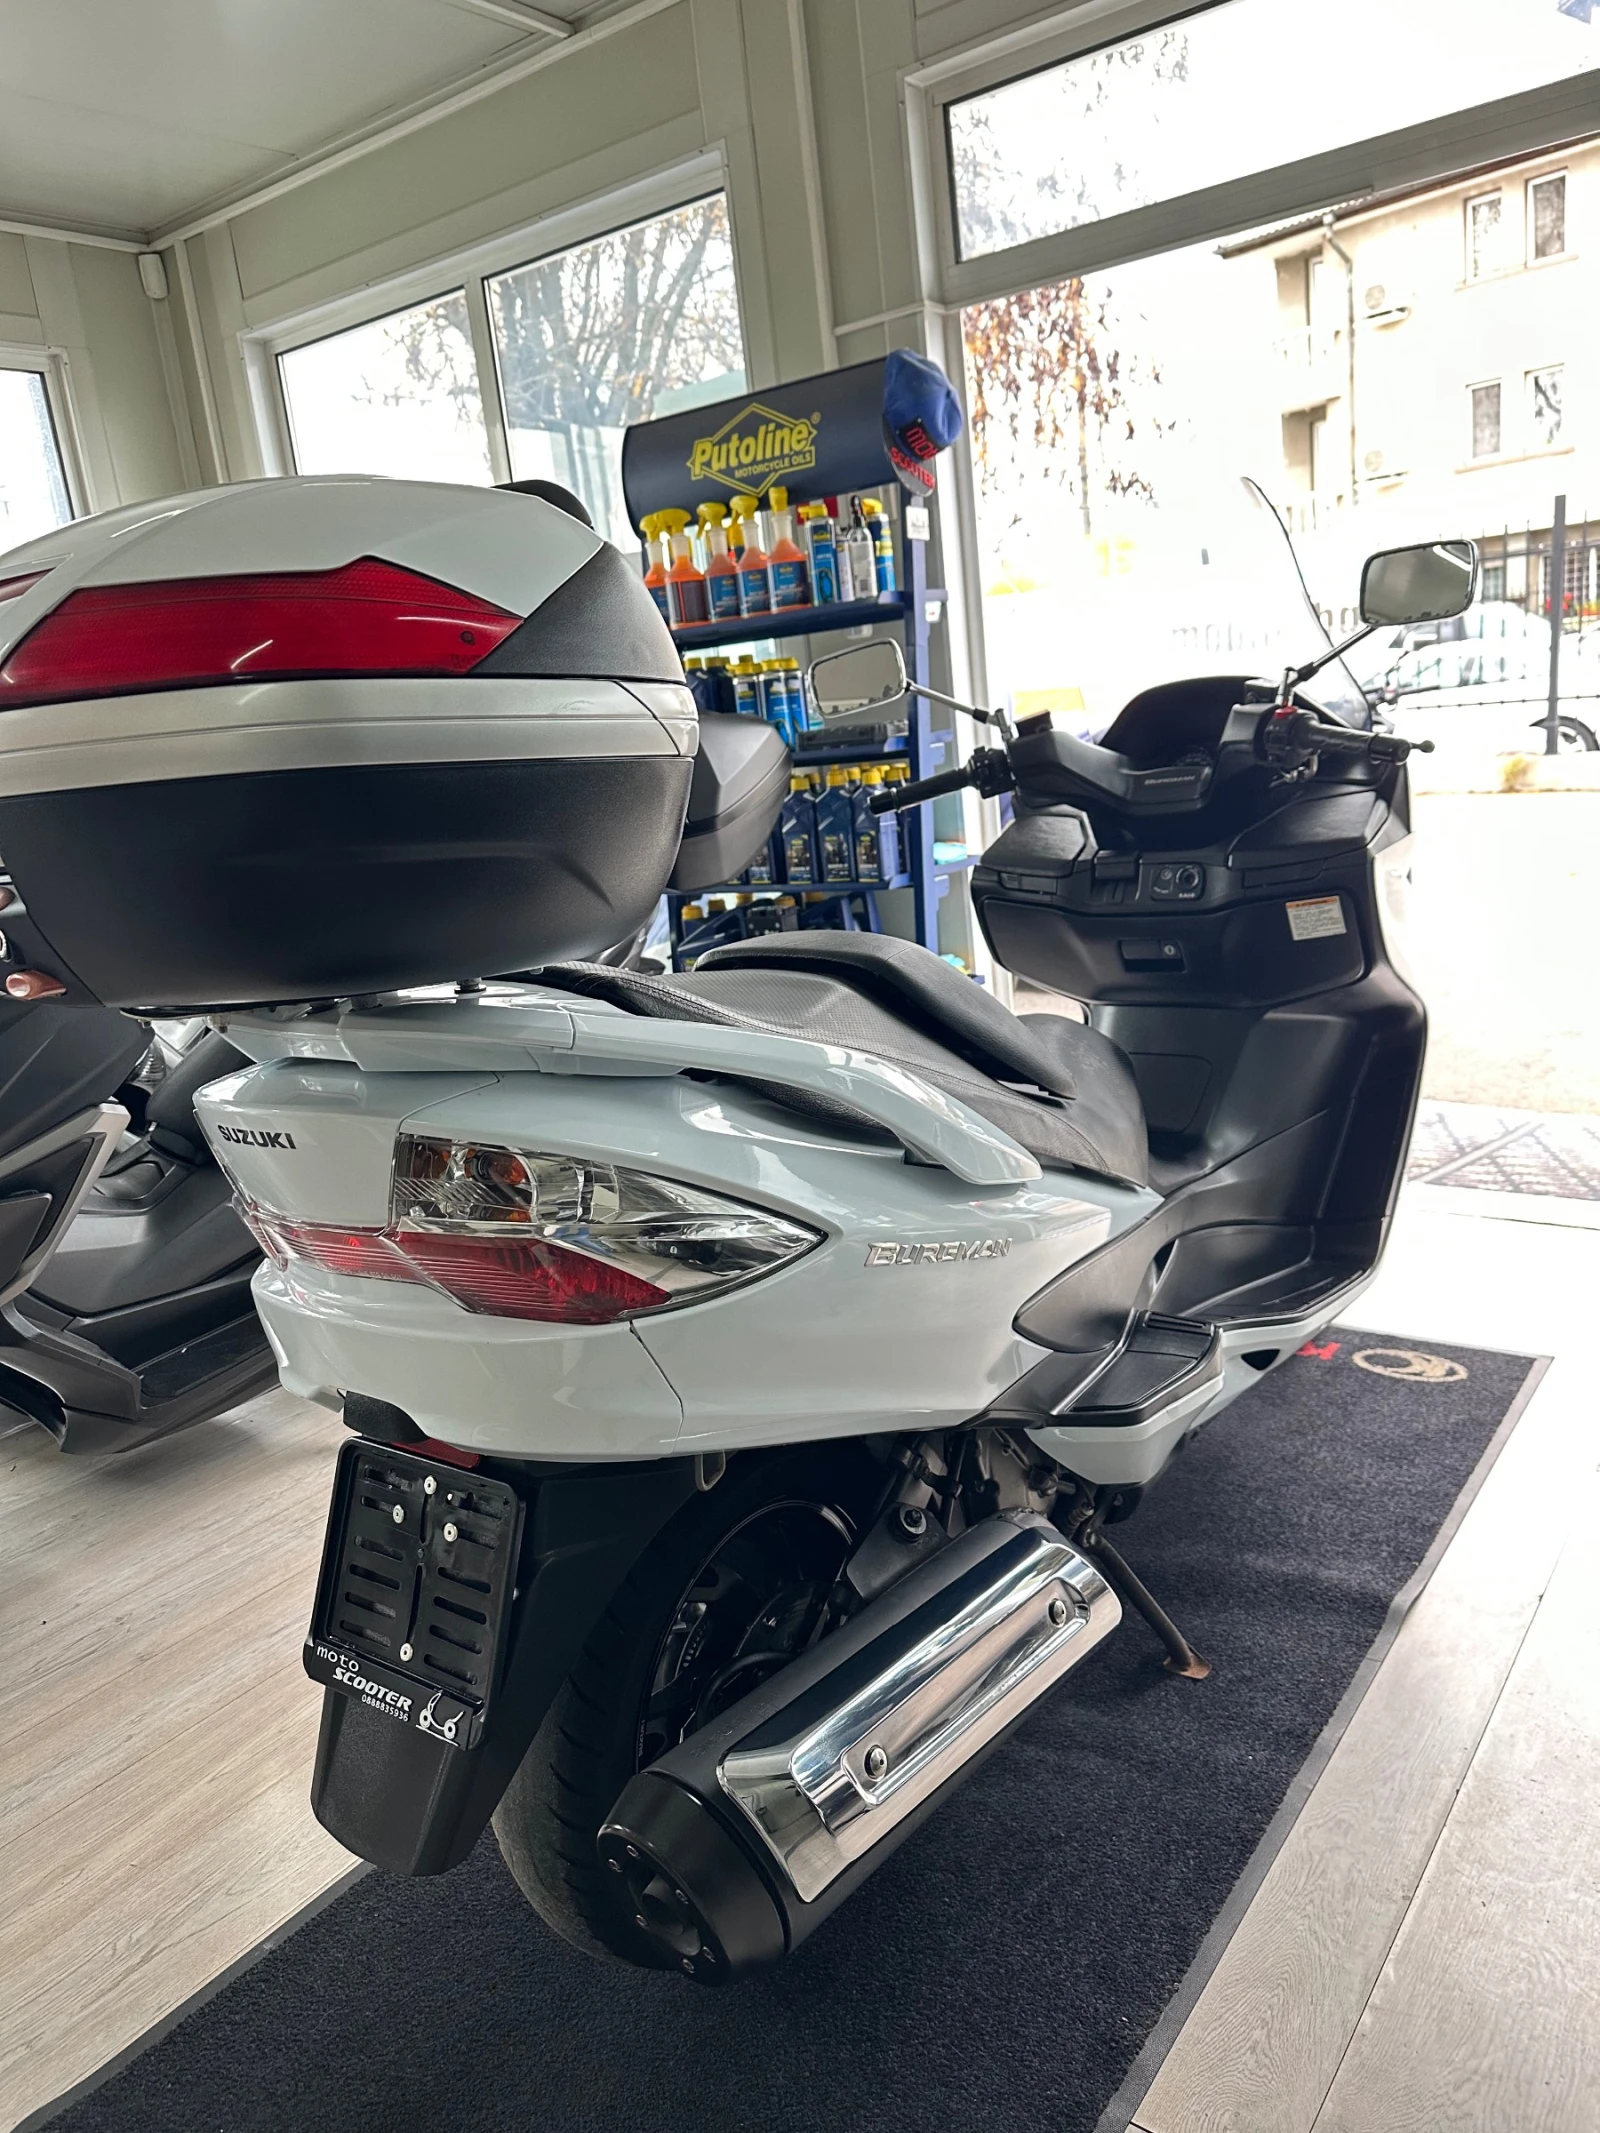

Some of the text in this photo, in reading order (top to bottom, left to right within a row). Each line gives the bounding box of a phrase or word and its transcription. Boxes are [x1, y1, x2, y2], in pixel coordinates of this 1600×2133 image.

[693, 421, 810, 476] Putoline
[734, 451, 811, 479] MOTORCYCLE OILS
[217, 1124, 297, 1150] SUZUKI
[864, 1237, 1013, 1268] BURGMAN
[316, 1645, 360, 1673] moto
[332, 1666, 413, 1712] SCOOTER
[361, 1694, 410, 1722] 0888835936
